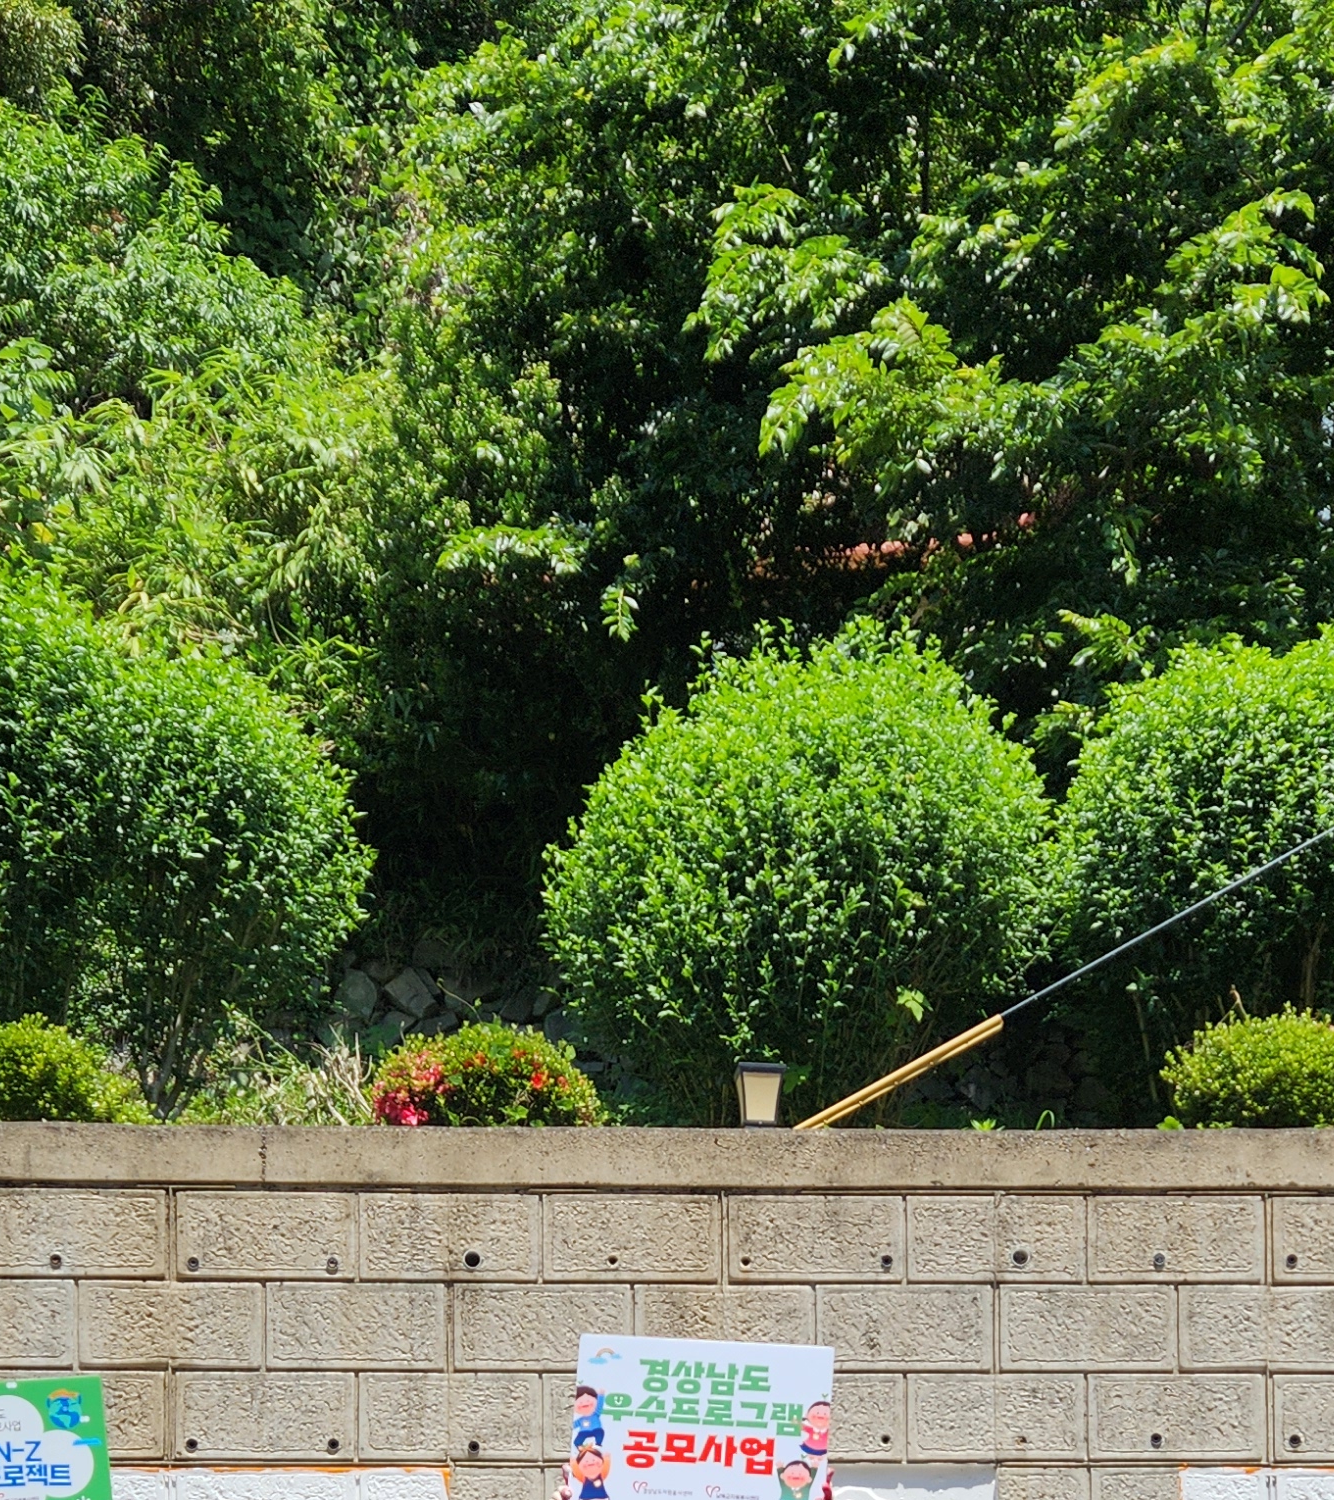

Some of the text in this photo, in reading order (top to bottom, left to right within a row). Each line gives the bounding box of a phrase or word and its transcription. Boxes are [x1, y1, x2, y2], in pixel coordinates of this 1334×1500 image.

[639, 1358, 771, 1396] 경상남도
[602, 1392, 804, 1437] 우수프로그램
[623, 1429, 775, 1475] 공모사업
